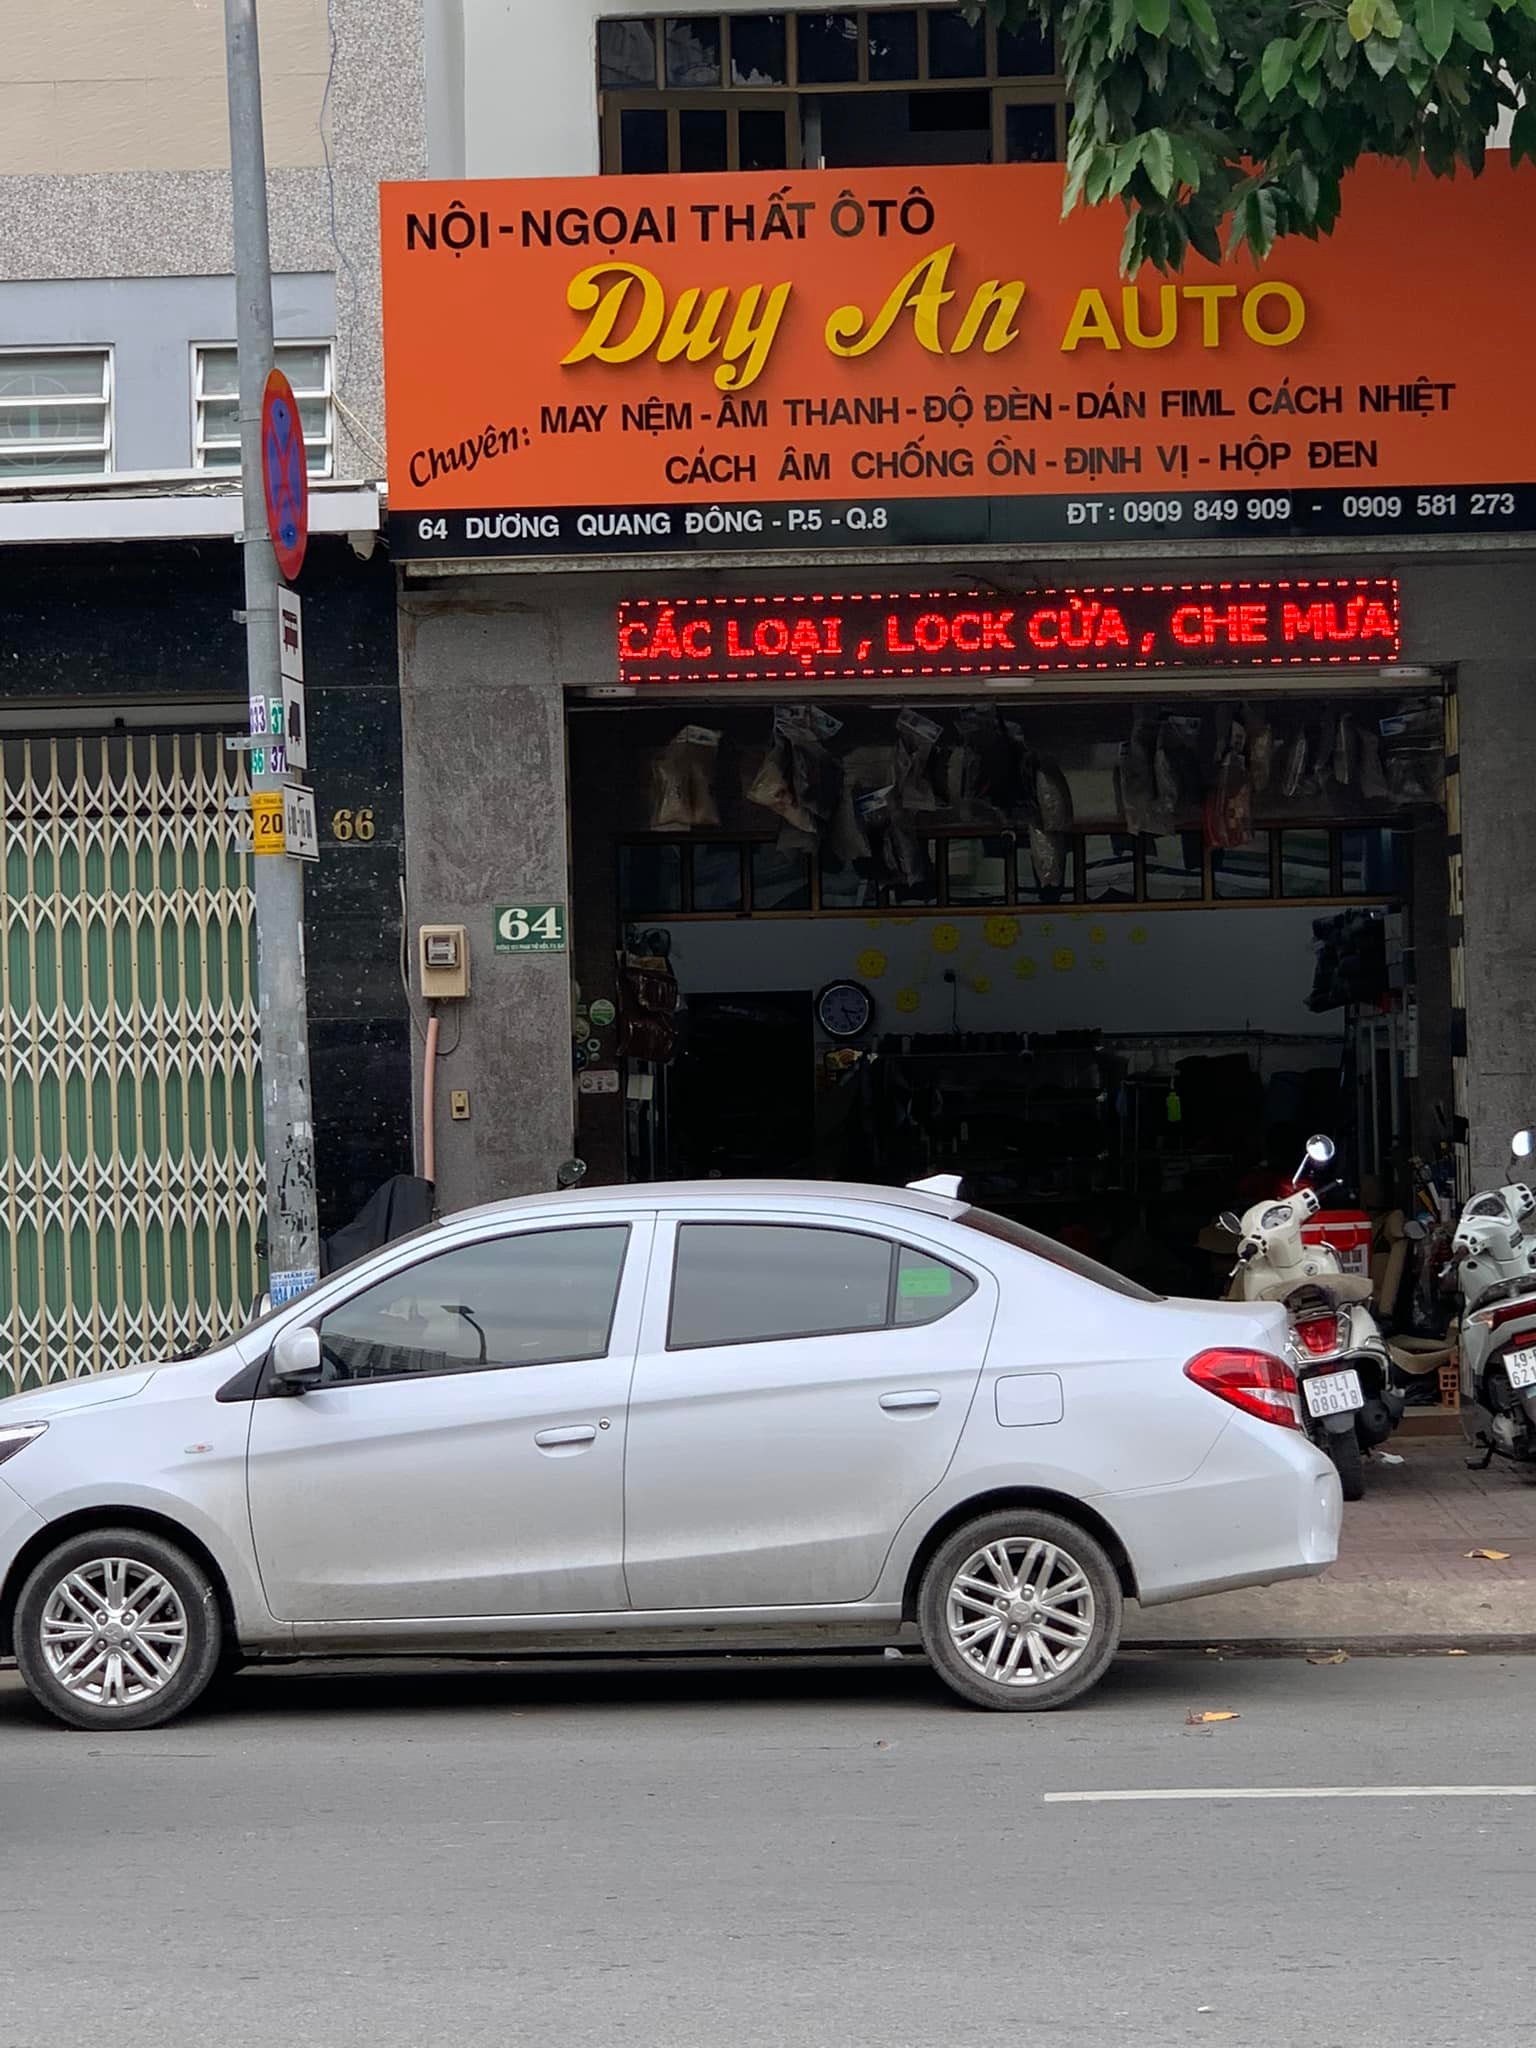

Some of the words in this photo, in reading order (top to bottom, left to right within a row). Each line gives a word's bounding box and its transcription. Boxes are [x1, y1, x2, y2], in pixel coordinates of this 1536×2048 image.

[690, 185, 816, 242] THẤT
[560, 261, 793, 391] Duy
[824, 242, 1026, 358] An
[1060, 281, 1306, 351] AUTO
[540, 404, 608, 433] MAY
[1160, 389, 1236, 418] FIML
[1247, 377, 1343, 416] CÁCH
[1358, 375, 1457, 418] NHIỆT
[408, 424, 531, 488] Chuyên:
[665, 446, 757, 484] CÁCH
[777, 445, 831, 481] ÂM
[850, 434, 975, 479] CHỐNG
[1307, 440, 1378, 469] ĐEN
[417, 518, 449, 540] 64
[465, 512, 561, 540] DƯƠNG
[576, 511, 672, 537] QUANG
[684, 505, 764, 534] ĐÔNG
[787, 508, 823, 531] P.5
[845, 506, 889, 530] Q.8
[1122, 500, 1183, 524] 0909
[1192, 499, 1239, 521] 849
[1246, 497, 1291, 521] 909
[1342, 495, 1402, 519] 0909
[1415, 493, 1457, 517] 581
[1469, 492, 1517, 516] 273
[617, 608, 713, 659] CÁC
[886, 609, 1017, 653] LOCK
[1170, 602, 1268, 645] CHE
[1282, 595, 1395, 642] MƯA
[260, 813, 283, 834] 20
[331, 808, 375, 841] 66
[498, 907, 562, 940] 64
[1311, 1374, 1349, 1396] 59-L1
[1311, 1389, 1359, 1414] 080.18
